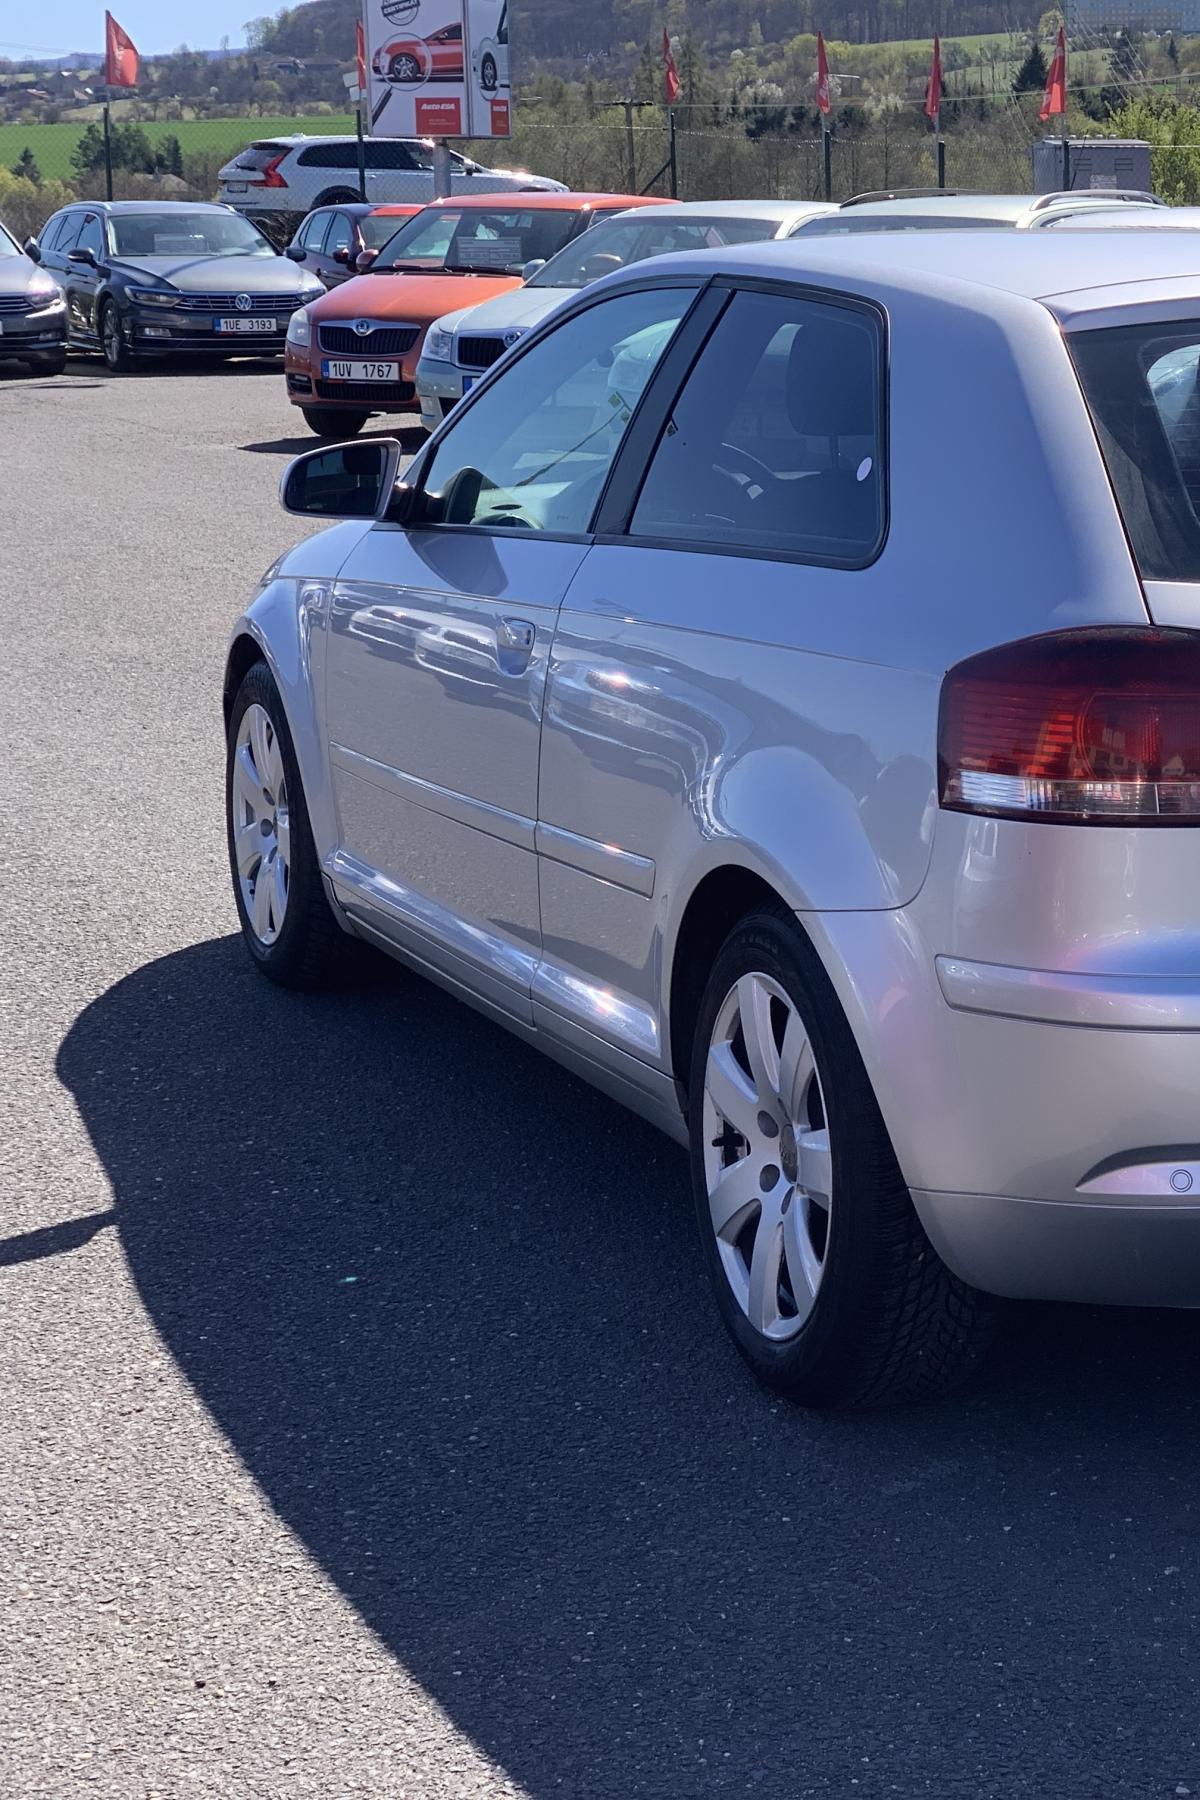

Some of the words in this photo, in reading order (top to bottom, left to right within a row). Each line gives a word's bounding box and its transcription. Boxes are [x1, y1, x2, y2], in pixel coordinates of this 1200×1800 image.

[223, 319, 241, 330] 1UE
[248, 319, 272, 330] 3193
[332, 363, 352, 378] 1UV
[362, 363, 392, 378] 1767
